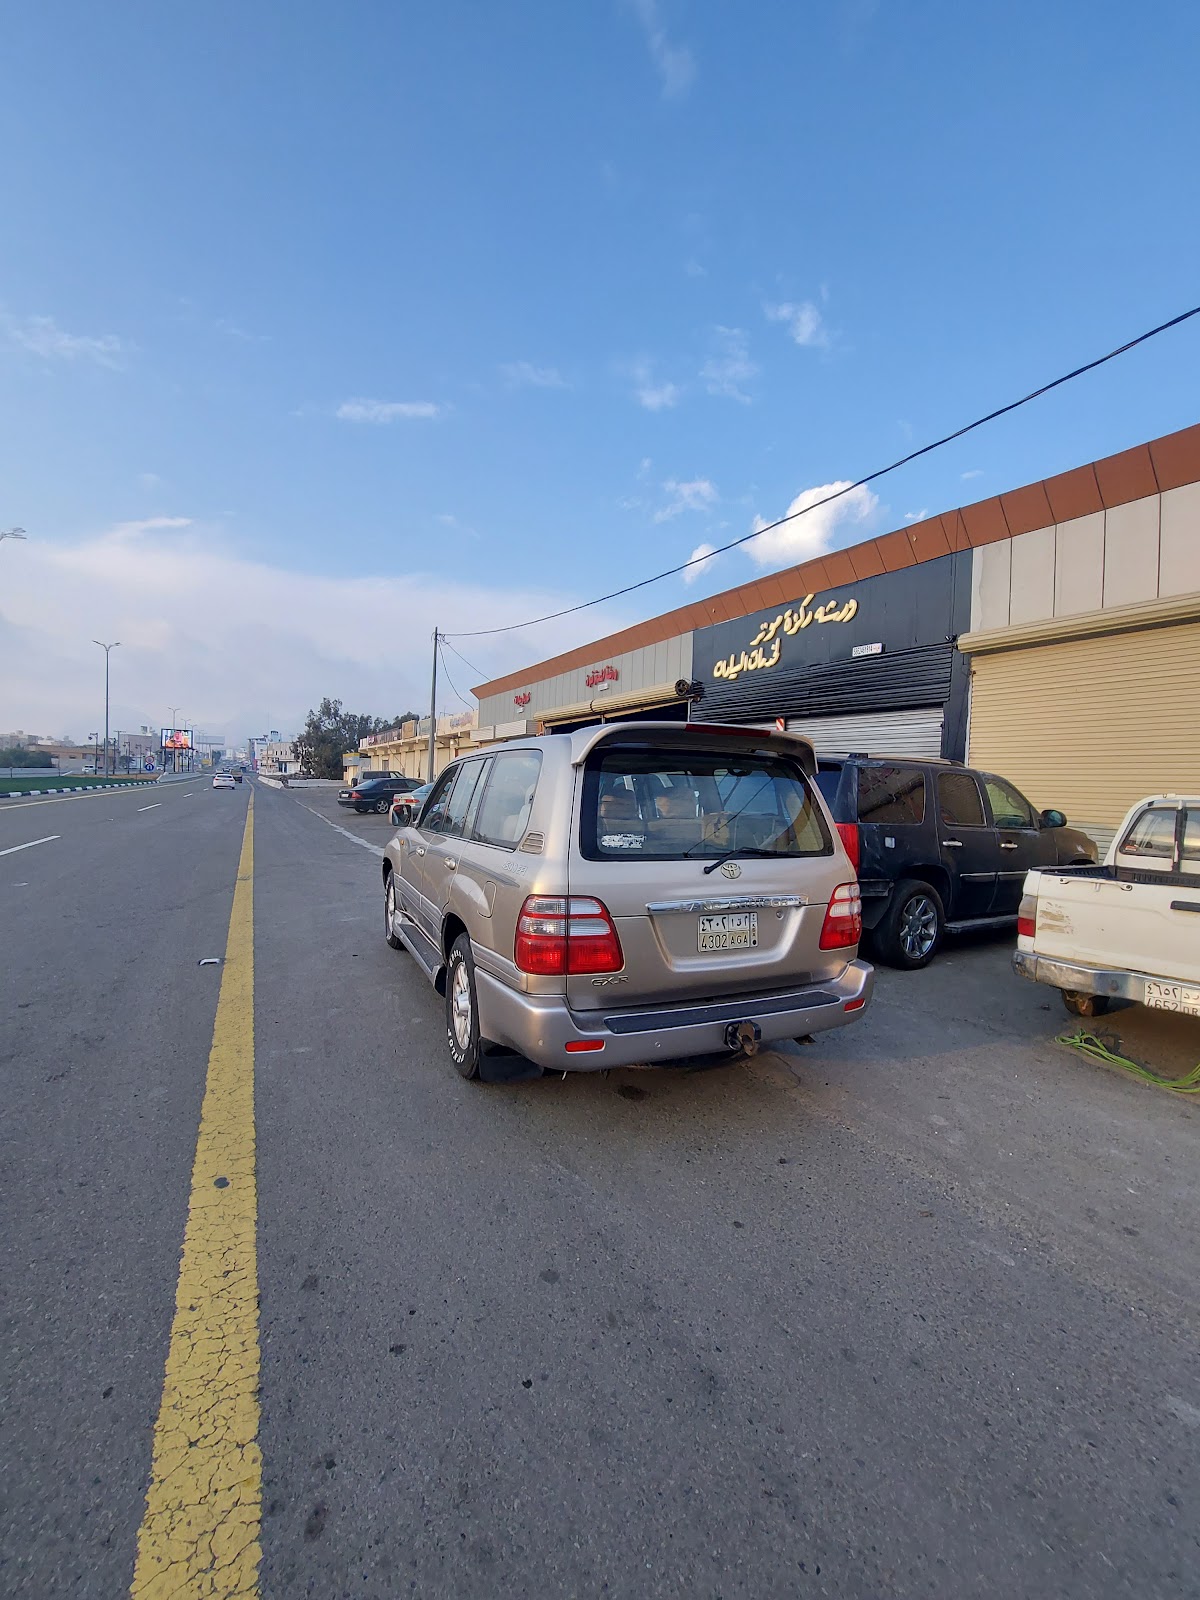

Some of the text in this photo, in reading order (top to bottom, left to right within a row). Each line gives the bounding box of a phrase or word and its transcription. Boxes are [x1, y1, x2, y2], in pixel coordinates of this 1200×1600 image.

[701, 916, 727, 932] ٤٣٠٢
[701, 934, 748, 949] 4302 AGA
[1147, 982, 1178, 998] ٤٦٥٢
